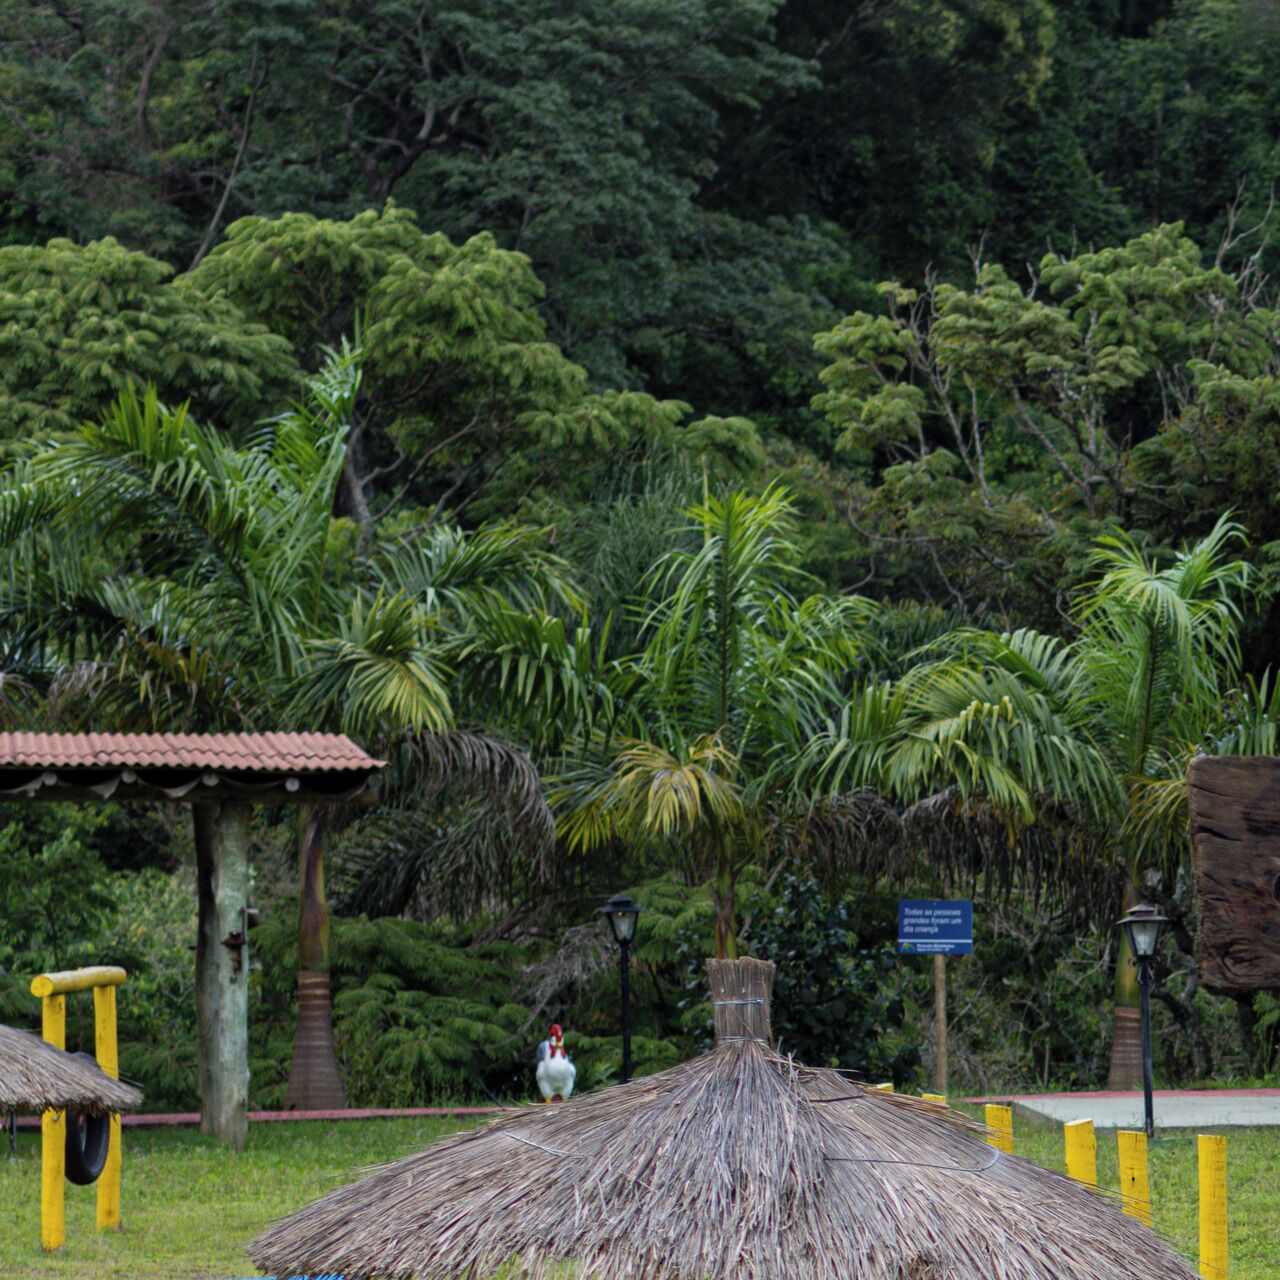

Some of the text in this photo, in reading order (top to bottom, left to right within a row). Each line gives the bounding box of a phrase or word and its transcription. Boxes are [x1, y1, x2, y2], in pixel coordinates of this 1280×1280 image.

[904, 908, 923, 916] Todas
[933, 908, 961, 917] pessoas
[903, 917, 930, 926] grandes
[914, 926, 938, 934] criança
